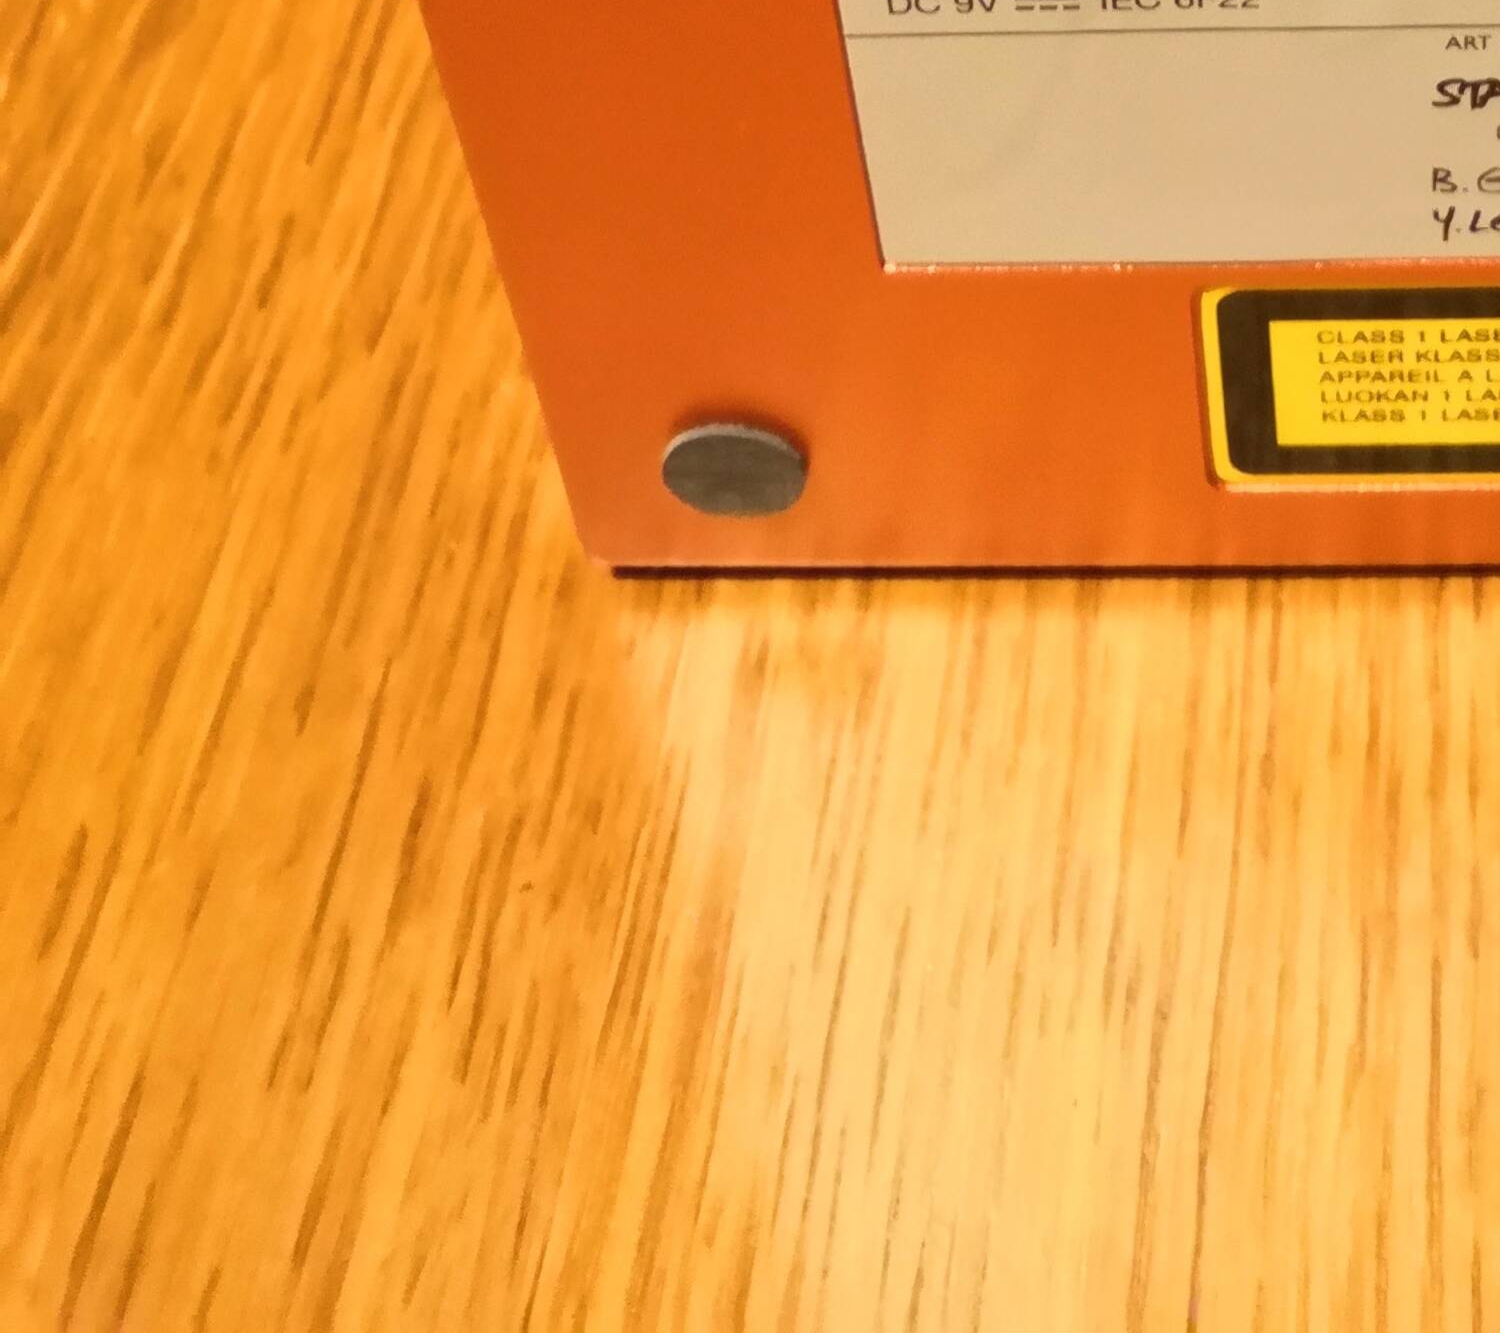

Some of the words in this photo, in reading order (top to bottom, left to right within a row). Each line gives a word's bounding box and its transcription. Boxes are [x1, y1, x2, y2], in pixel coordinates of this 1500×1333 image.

[1445, 34, 1491, 51] ART
[1316, 328, 1406, 345] CLASS
[1418, 330, 1426, 342] 1
[1318, 349, 1405, 365] LASER
[1319, 368, 1442, 384] APPAREIL
[1320, 388, 1429, 404] LUOKAN
[1443, 388, 1451, 402] 1
[1321, 408, 1406, 423] KLASS
[1420, 408, 1427, 421] 1
